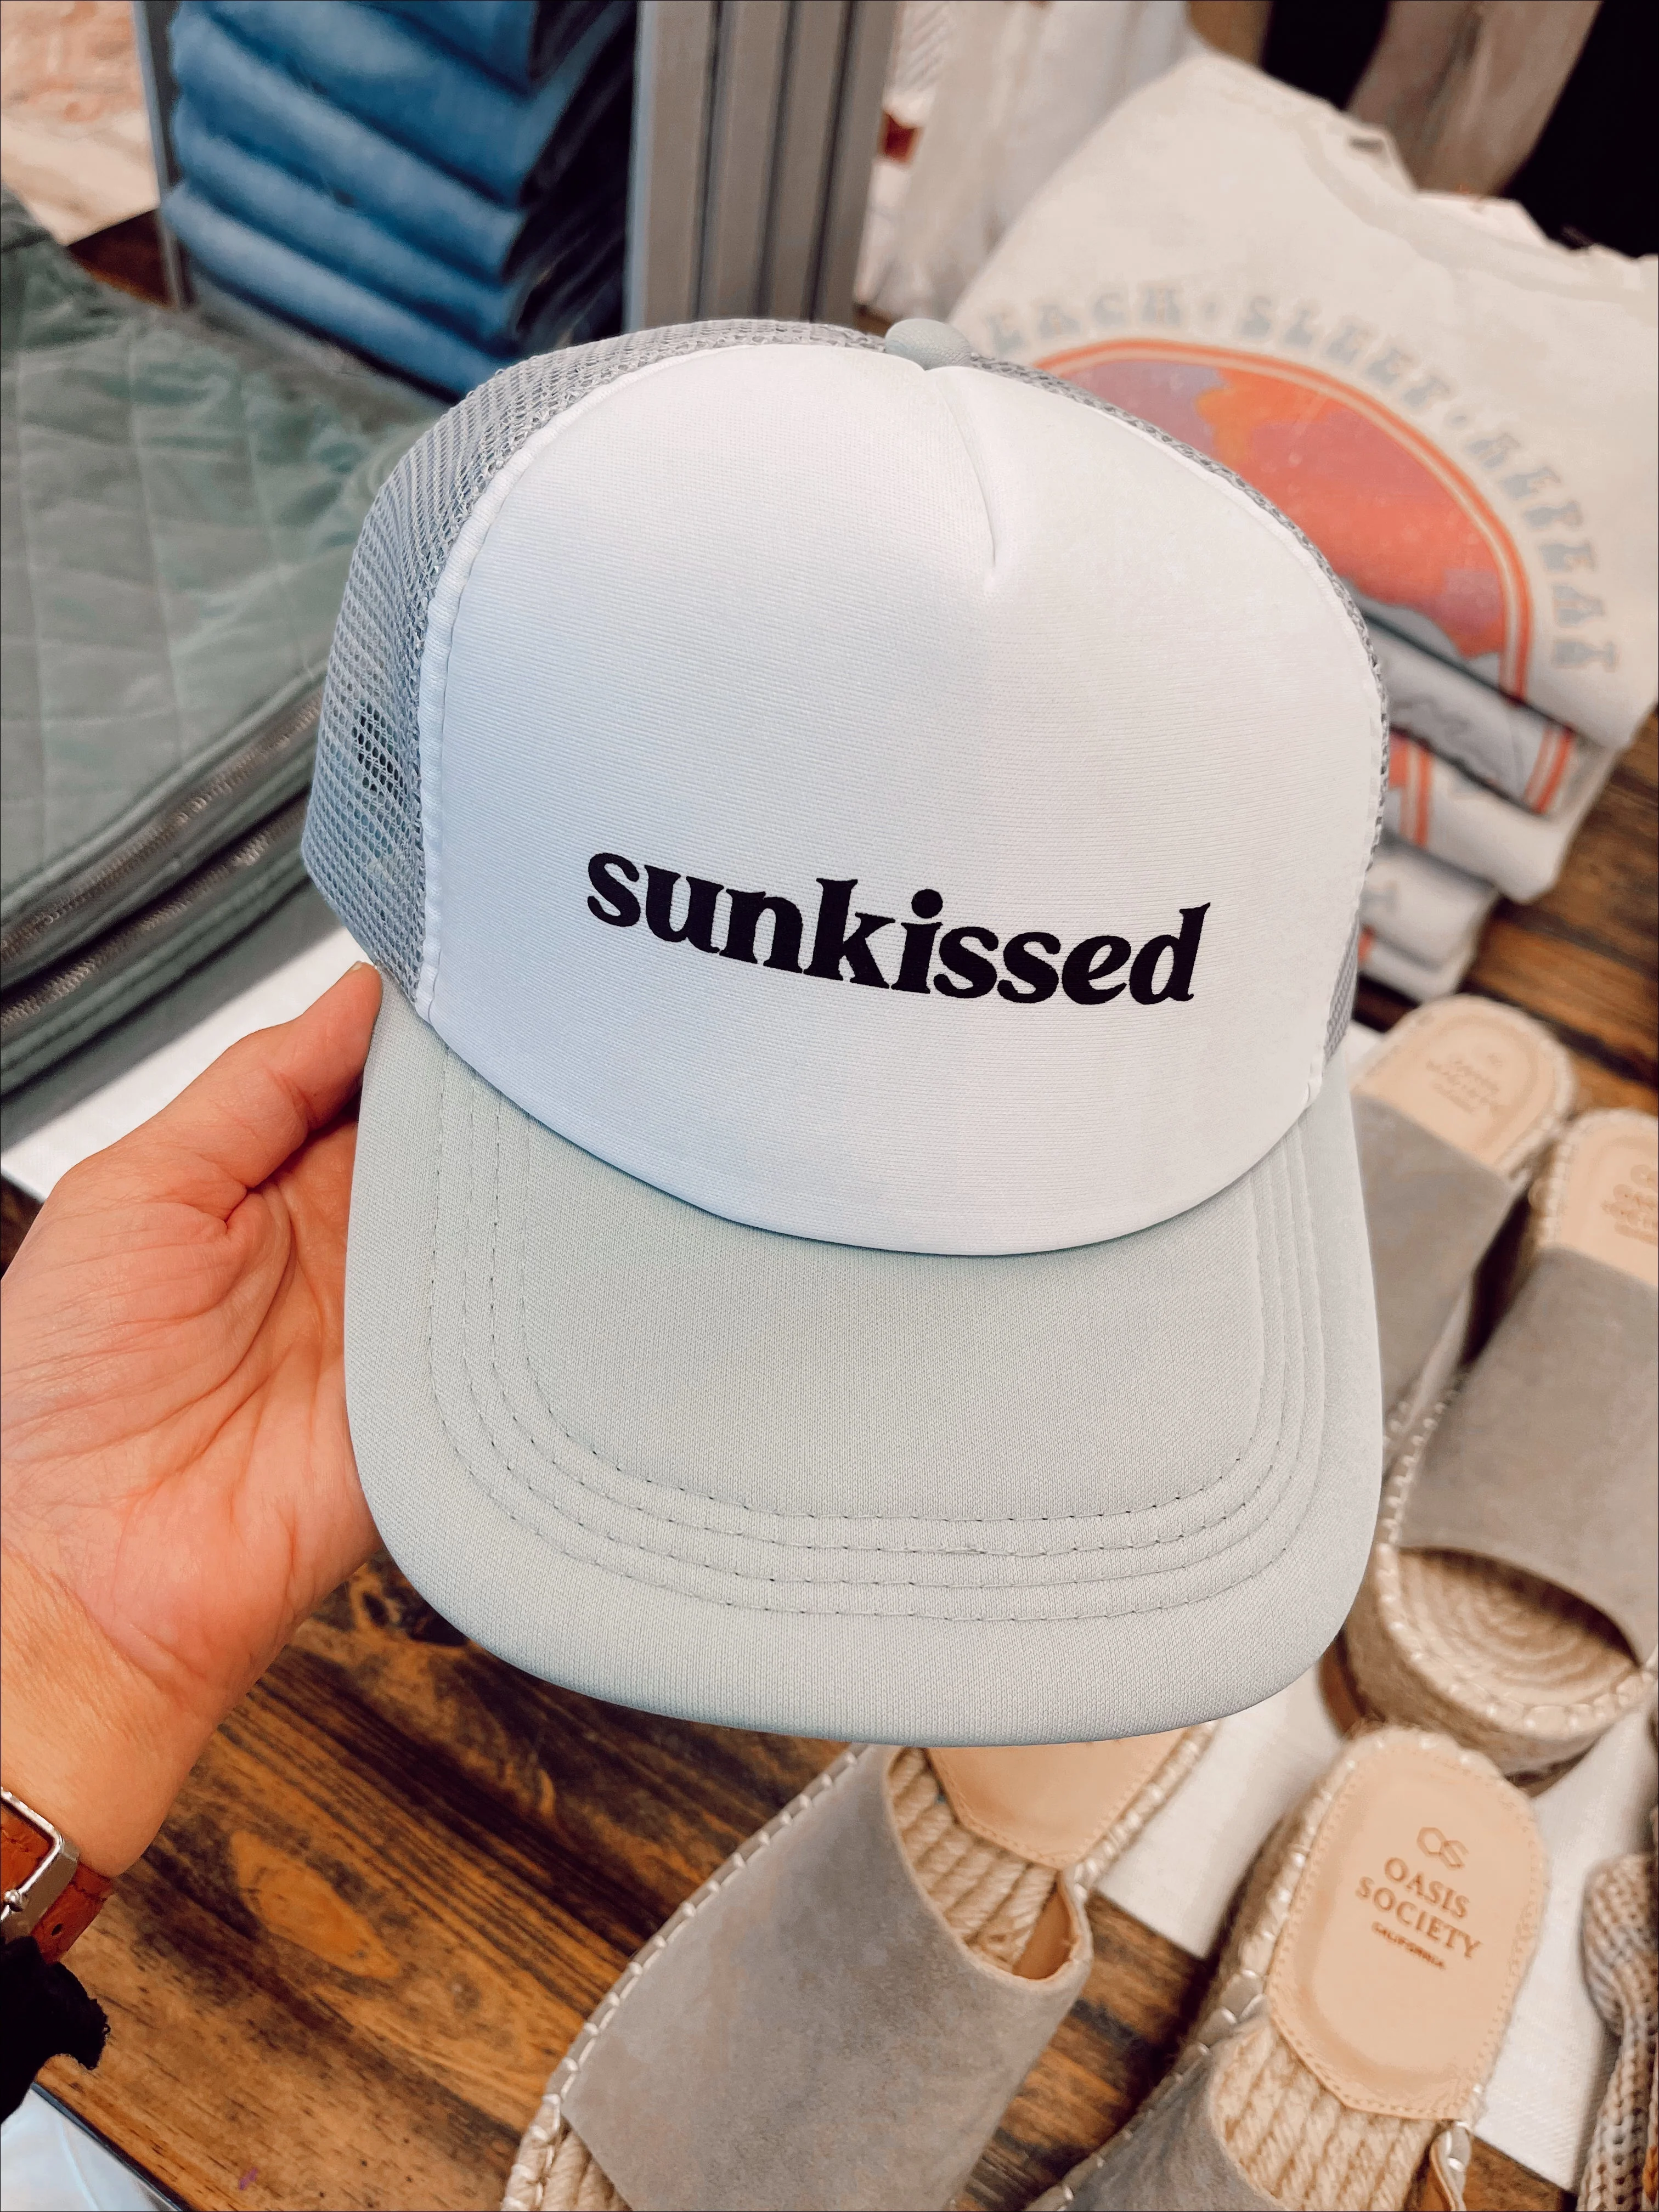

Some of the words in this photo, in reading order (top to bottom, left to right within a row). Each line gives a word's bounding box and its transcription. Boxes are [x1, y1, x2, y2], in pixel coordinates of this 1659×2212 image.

[986, 282, 1182, 352] EACH
[1240, 294, 1453, 405] SLEEP
[1468, 432, 1620, 673] REPEAT
[587, 852, 1211, 1005] sunkissed
[1355, 1876, 1482, 1960] SOCIETY
[1384, 1857, 1470, 1920] OASIS
